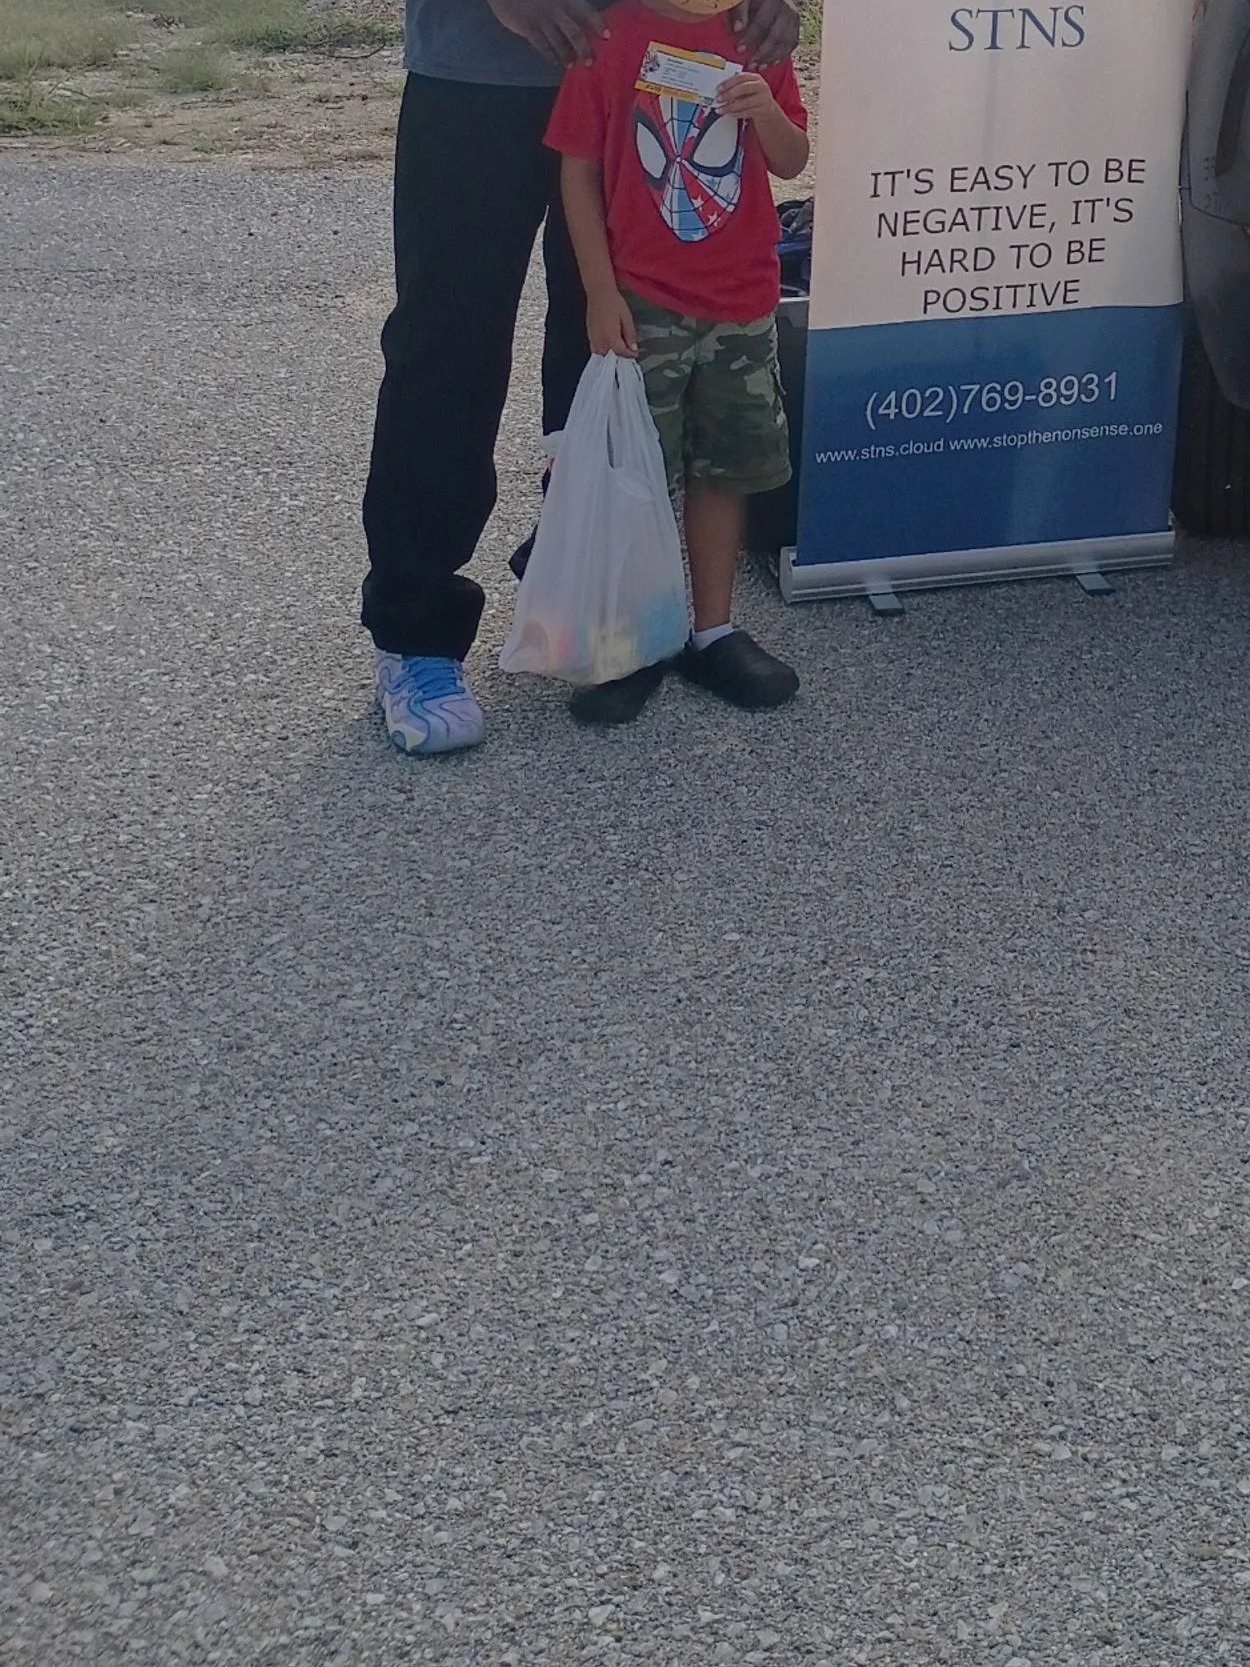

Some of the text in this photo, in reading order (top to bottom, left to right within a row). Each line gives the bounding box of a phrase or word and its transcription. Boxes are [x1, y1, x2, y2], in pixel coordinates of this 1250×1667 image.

[948, 4, 1086, 52] STNS
[869, 157, 1147, 199] IT'S EASY TO BE
[876, 197, 1134, 239] NEGATIVE, IT'S
[900, 238, 1107, 277] HARD TO BE
[922, 279, 1081, 315] POSITIVE
[865, 371, 1118, 430] (402)769-8931
[815, 420, 1163, 463] www.stns.cloud www.stopthenonsense.one
